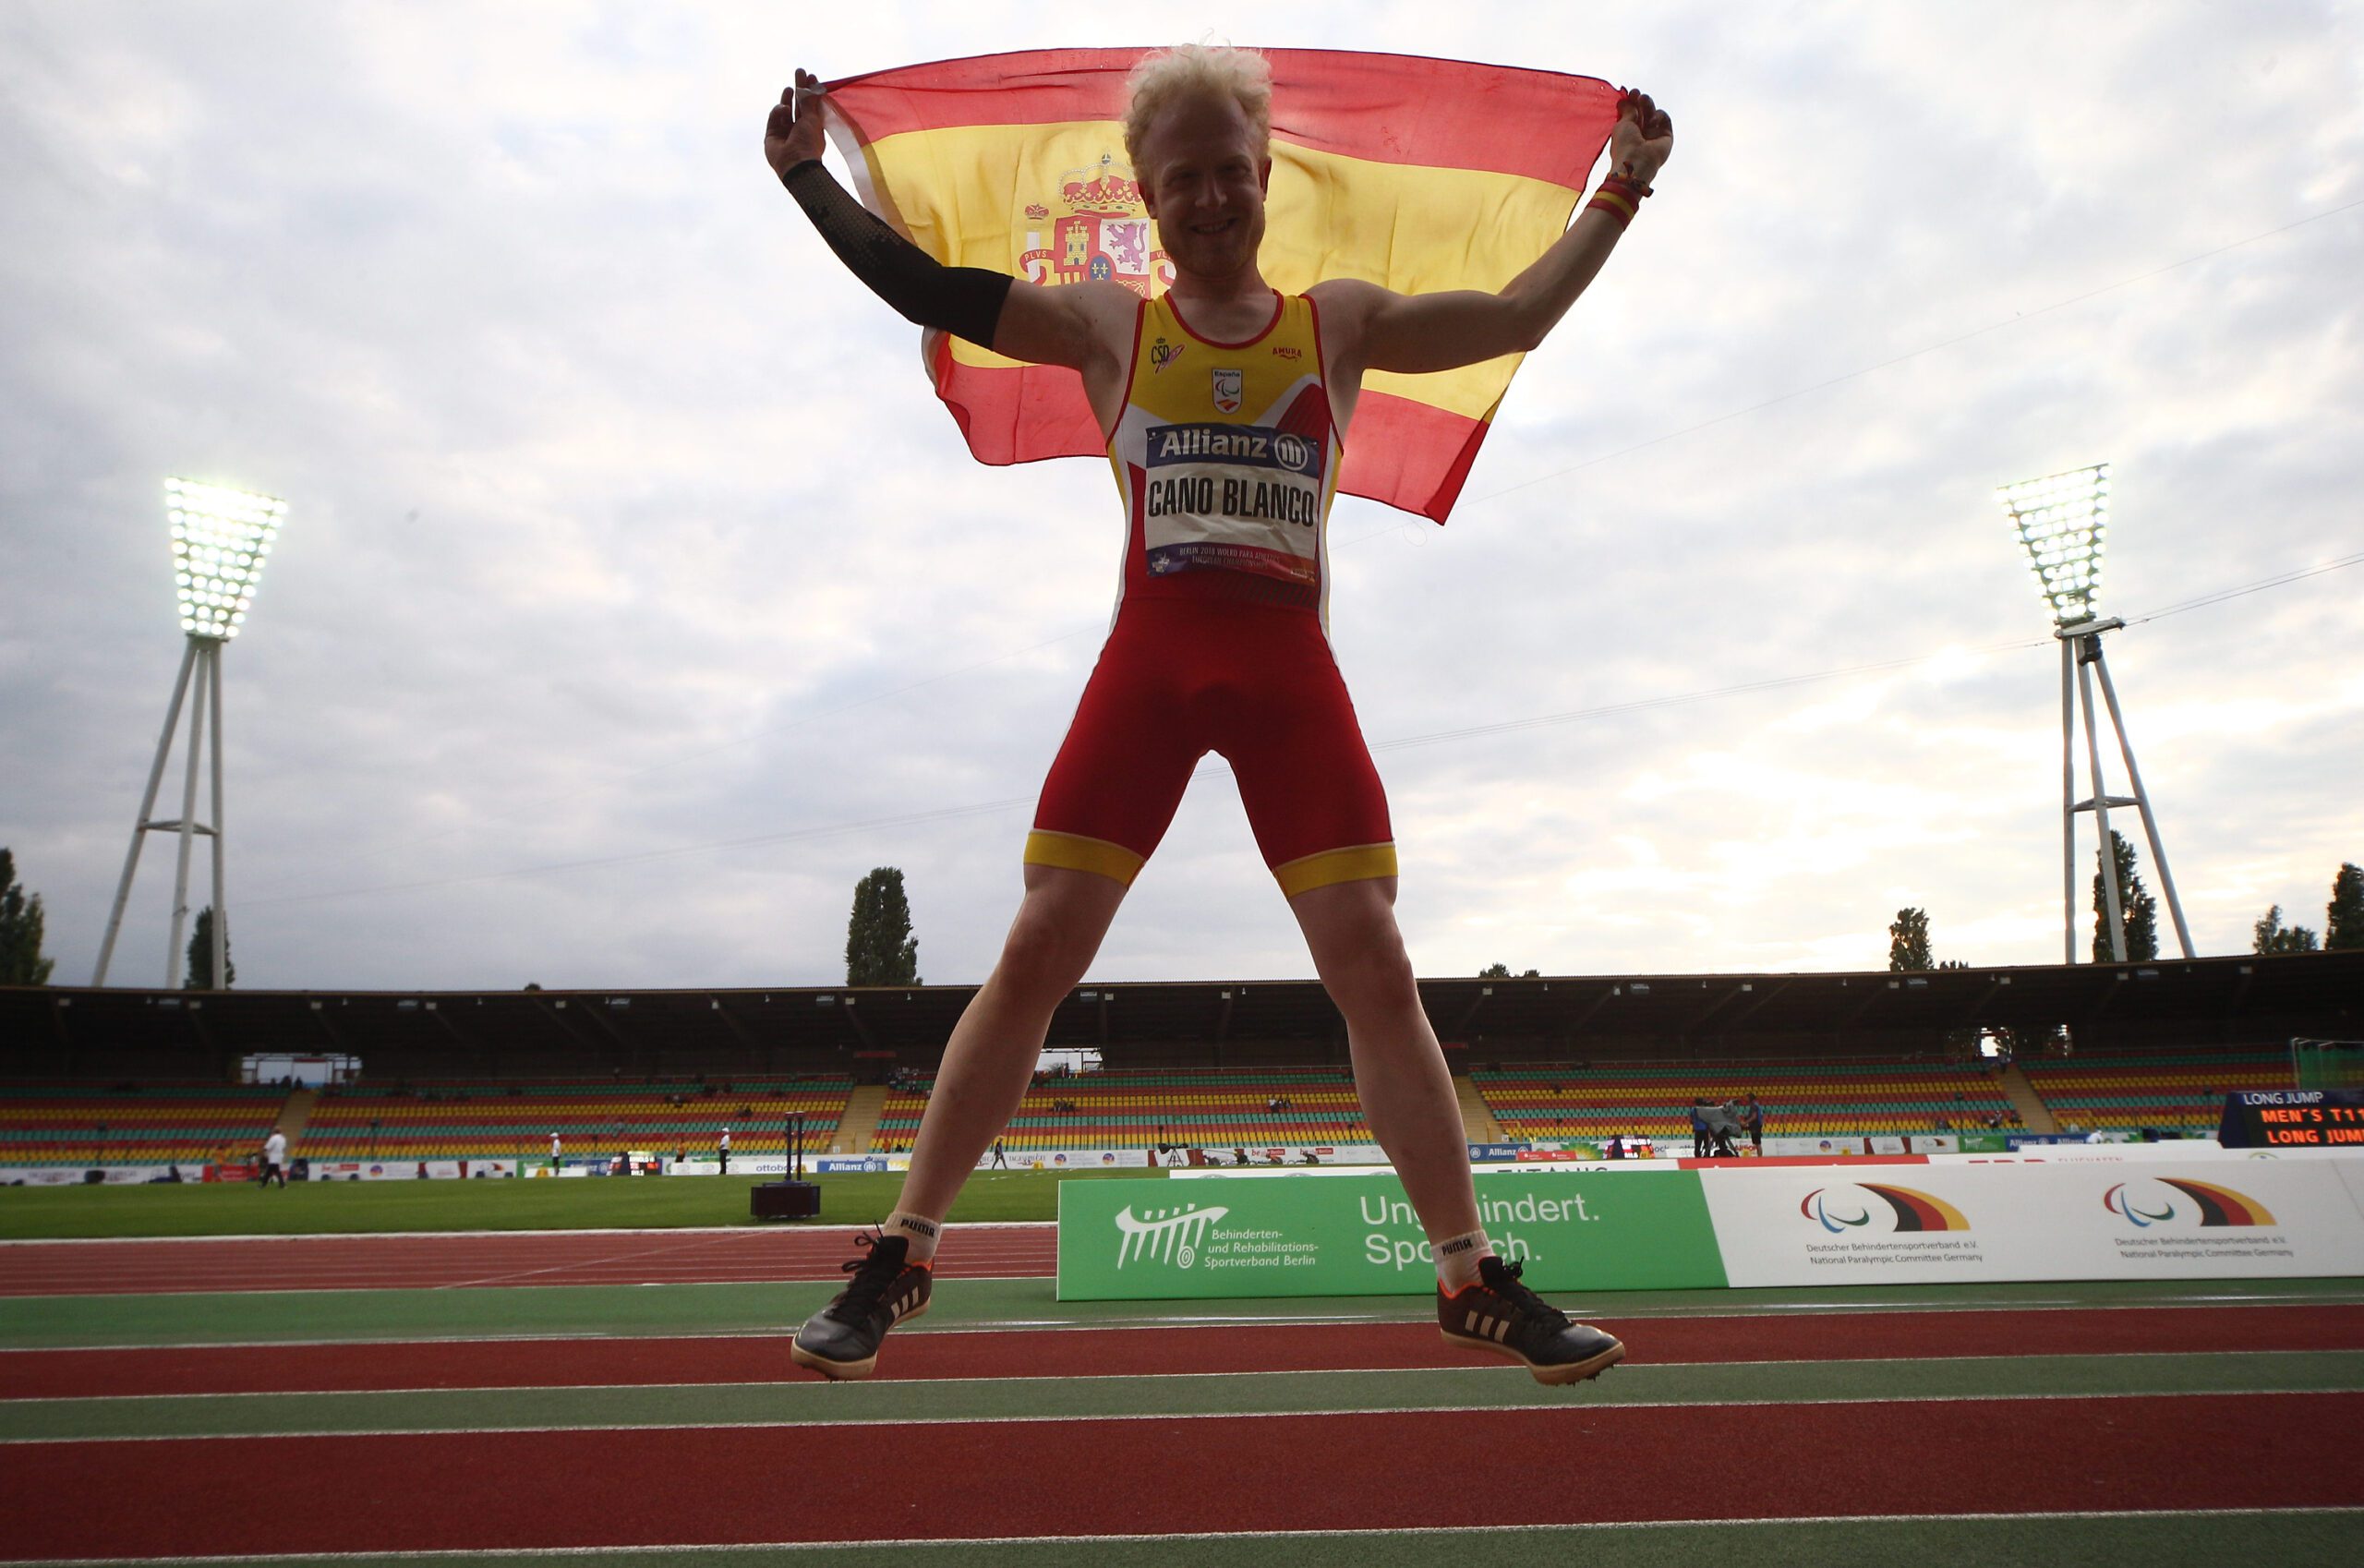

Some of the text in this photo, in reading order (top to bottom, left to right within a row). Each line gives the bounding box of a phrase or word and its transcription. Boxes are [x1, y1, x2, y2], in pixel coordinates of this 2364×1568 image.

[1024, 249, 1048, 261] PLVS
[1152, 344, 1170, 365] CSD
[1272, 347, 1302, 358] AMURA
[1159, 428, 1268, 459] Allianz
[1148, 477, 1315, 527] CANO BLANCO
[2243, 1092, 2323, 1104] LONG JUMP
[2267, 1128, 2364, 1144] LONG JUM
[1489, 1148, 1516, 1157] Allianz
[828, 1162, 862, 1171] Allianz
[900, 1218, 935, 1238] PUMA
[1212, 1228, 1283, 1240] Behinderten-
[1208, 1241, 1319, 1253] und Rehabilitations-
[1441, 1238, 1473, 1256] PUMA
[1806, 1243, 1850, 1253] Deutscher
[1851, 1241, 1960, 1252] Behindertensportverband
[1204, 1255, 1316, 1270] Sportverband Berlin
[1810, 1253, 1984, 1266] National Paralympic Committee Germany
